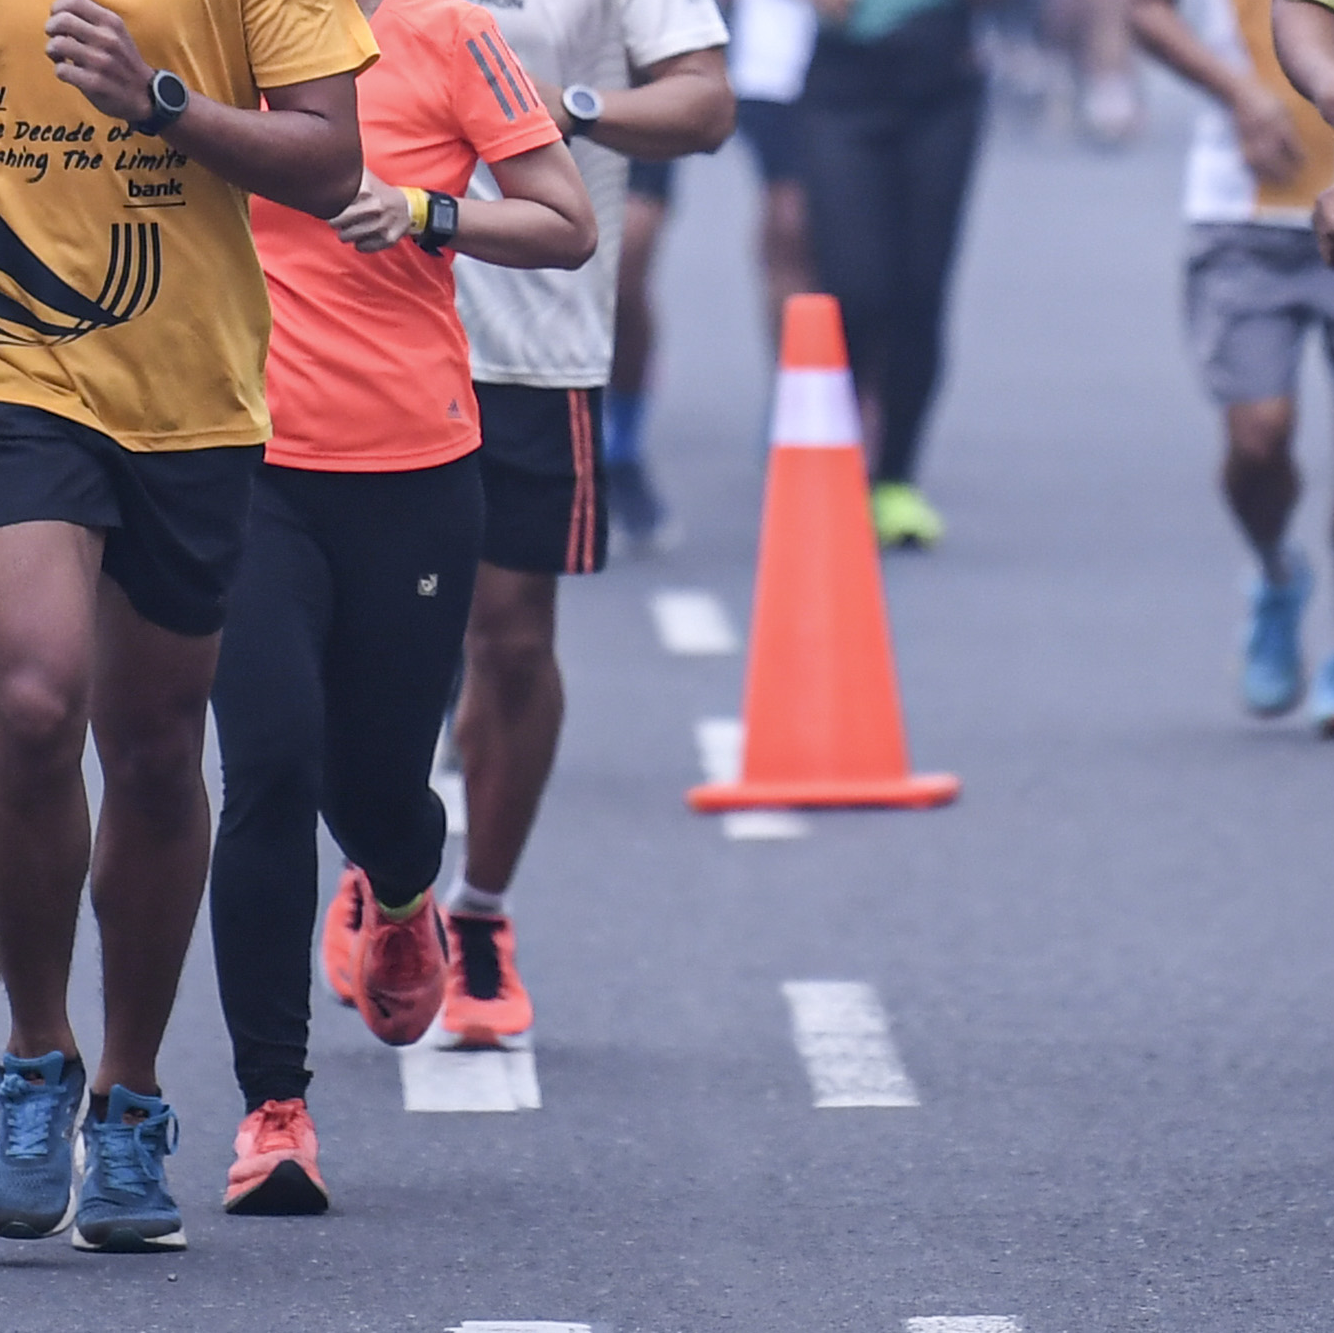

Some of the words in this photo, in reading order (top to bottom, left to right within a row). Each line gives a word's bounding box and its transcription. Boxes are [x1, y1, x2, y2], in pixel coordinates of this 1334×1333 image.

[13, 121, 95, 142] Decade
[63, 149, 104, 170] The
[114, 147, 188, 172] Limits
[127, 178, 184, 198] bank
